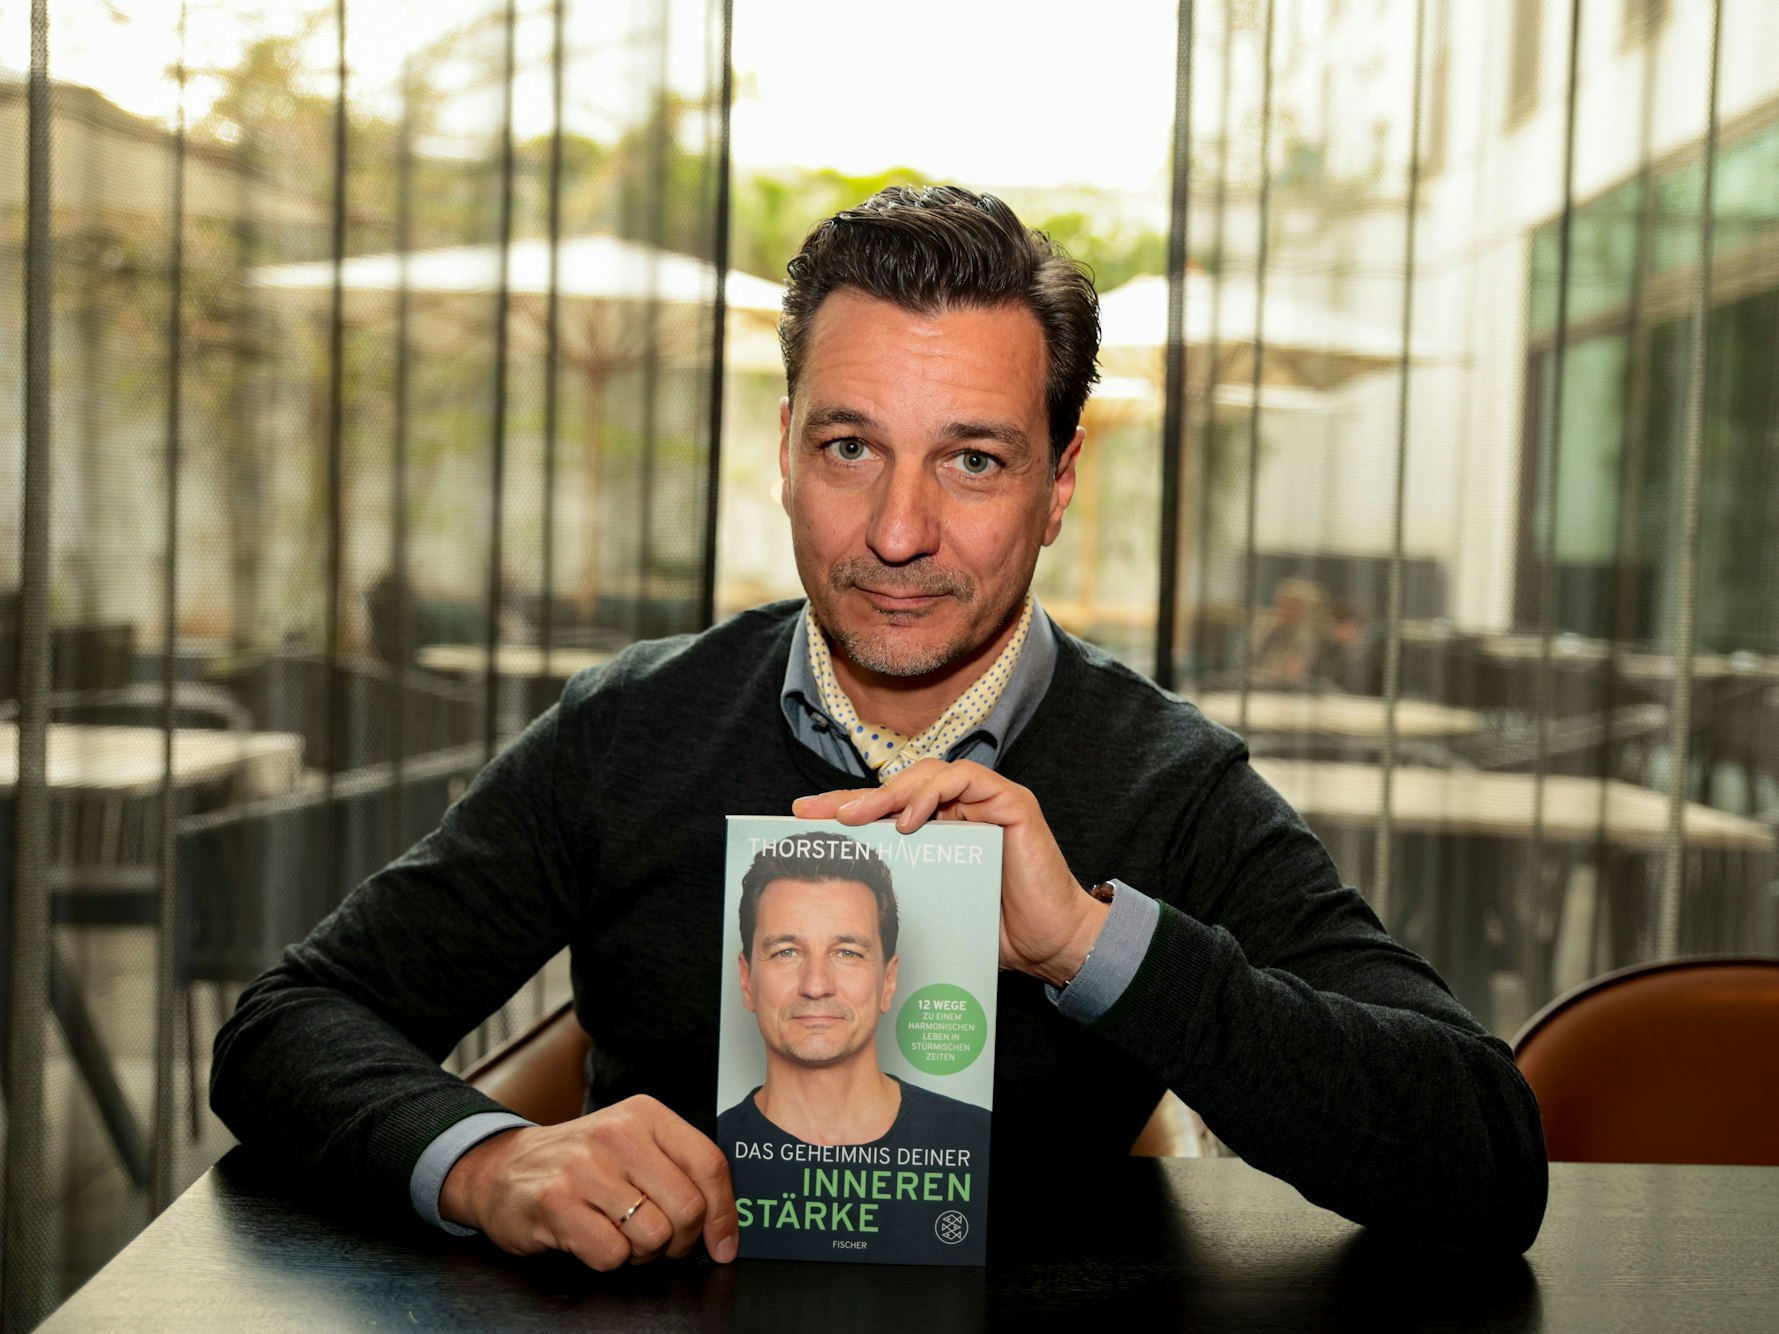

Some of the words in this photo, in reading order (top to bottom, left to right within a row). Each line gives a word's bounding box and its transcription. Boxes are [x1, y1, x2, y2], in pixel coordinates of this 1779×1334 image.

[748, 837, 870, 861] THORSTEN
[877, 837, 983, 869] HAVENER
[918, 1000, 930, 1010] 12
[933, 1000, 967, 1011] WEGE
[922, 1012, 934, 1020] ZU
[936, 1013, 962, 1021] EINEM
[908, 1022, 975, 1031] HARMONISCHEN
[922, 1033, 949, 1041] LEBEN
[951, 1033, 960, 1041] IN
[911, 1041, 970, 1051] STÜRMISCHEN
[926, 1053, 955, 1061] ZEITEN
[735, 1141, 774, 1160] DAS
[780, 1143, 891, 1165] GEHEIMNIS
[897, 1147, 970, 1167] DEINER
[803, 1167, 972, 1202] INNEREN
[735, 1192, 880, 1233] STÄRKE
[832, 1240, 868, 1250] FISCHER
